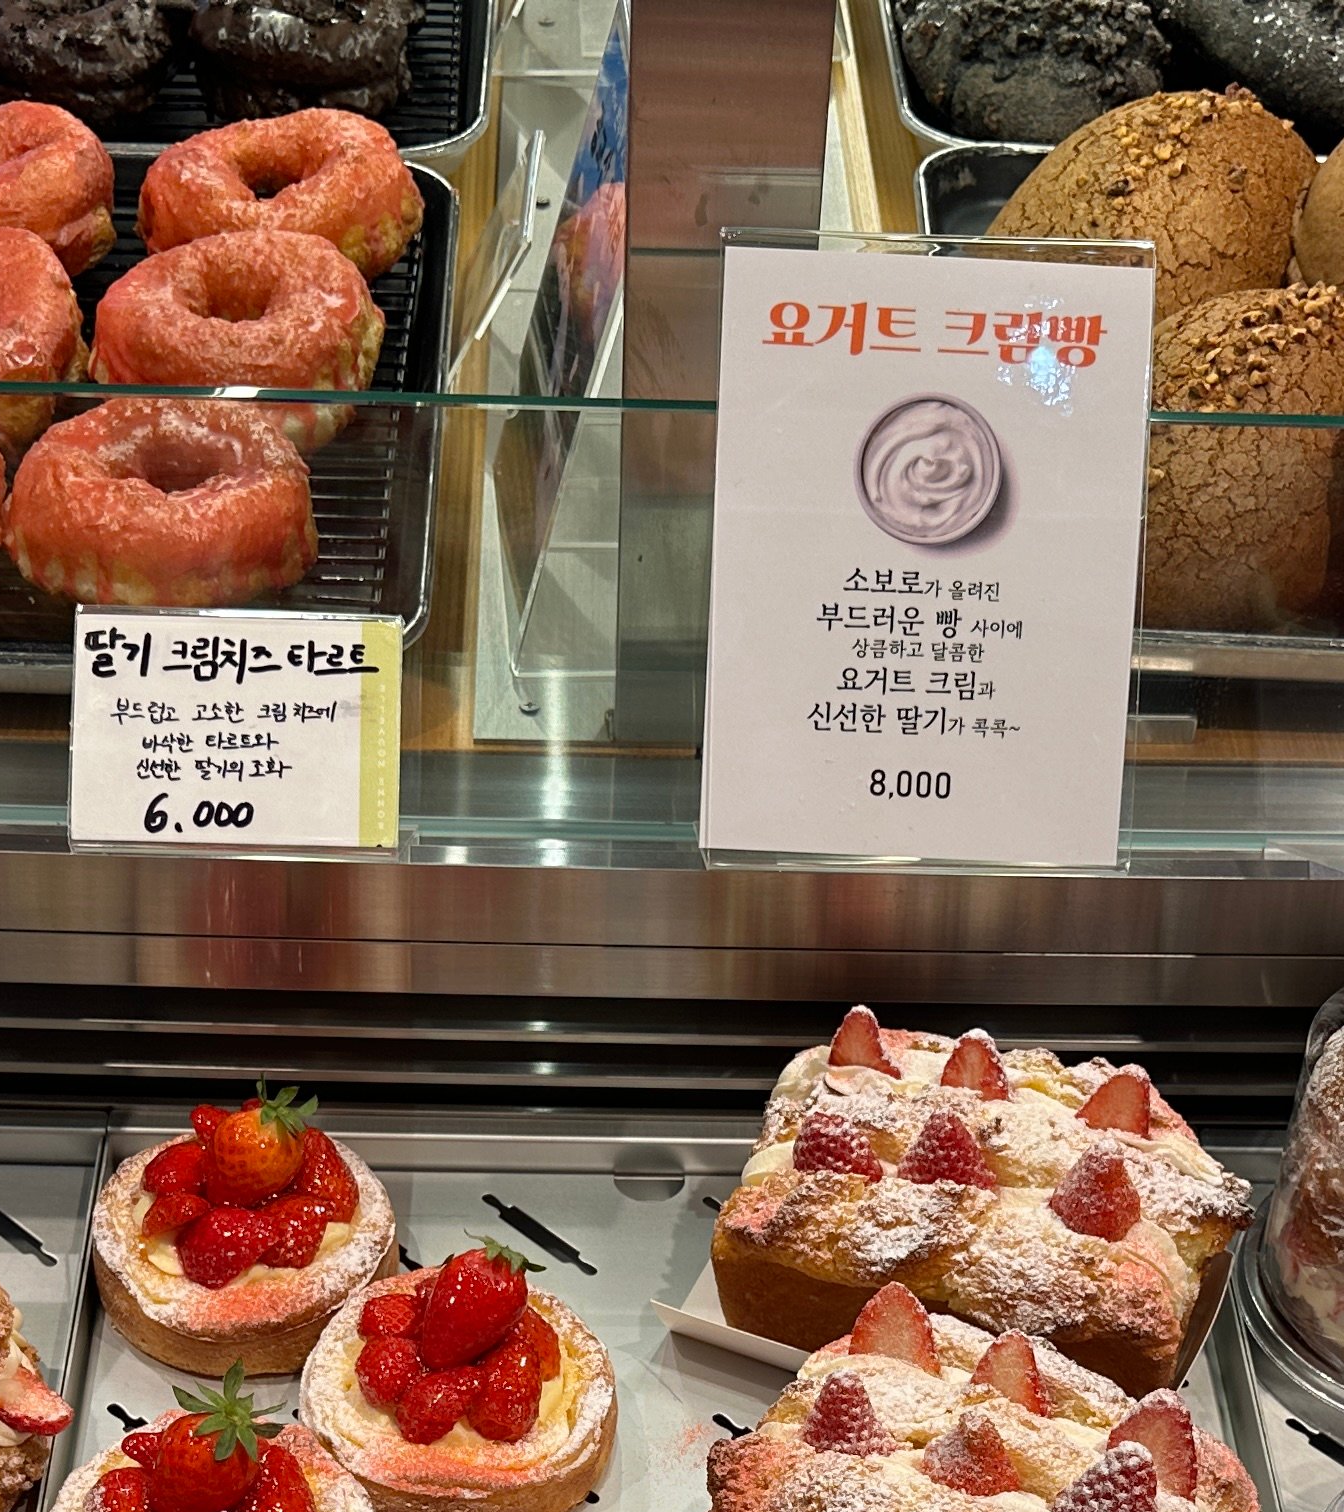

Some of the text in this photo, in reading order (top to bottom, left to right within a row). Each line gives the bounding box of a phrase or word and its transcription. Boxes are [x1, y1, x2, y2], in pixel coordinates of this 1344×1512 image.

[762, 301, 1109, 369] 요거트 크림빵
[842, 567, 1001, 603] 소보로가 올려진
[816, 602, 1024, 641] 부드러운 빵 사이에
[84, 627, 380, 685] 딸기 크림치즈 타르트
[851, 638, 985, 664] 상큼하고 달콤한
[836, 667, 996, 701] 요거트 크림과
[110, 698, 180, 724] 부드럽고
[191, 701, 245, 723] 고소한
[807, 701, 887, 736] 신선한
[896, 706, 966, 736] 딸기가
[142, 733, 280, 754] 바삭한 타르트와
[136, 758, 293, 782] 신선한 딸기의 조화
[869, 769, 952, 800] 8,000
